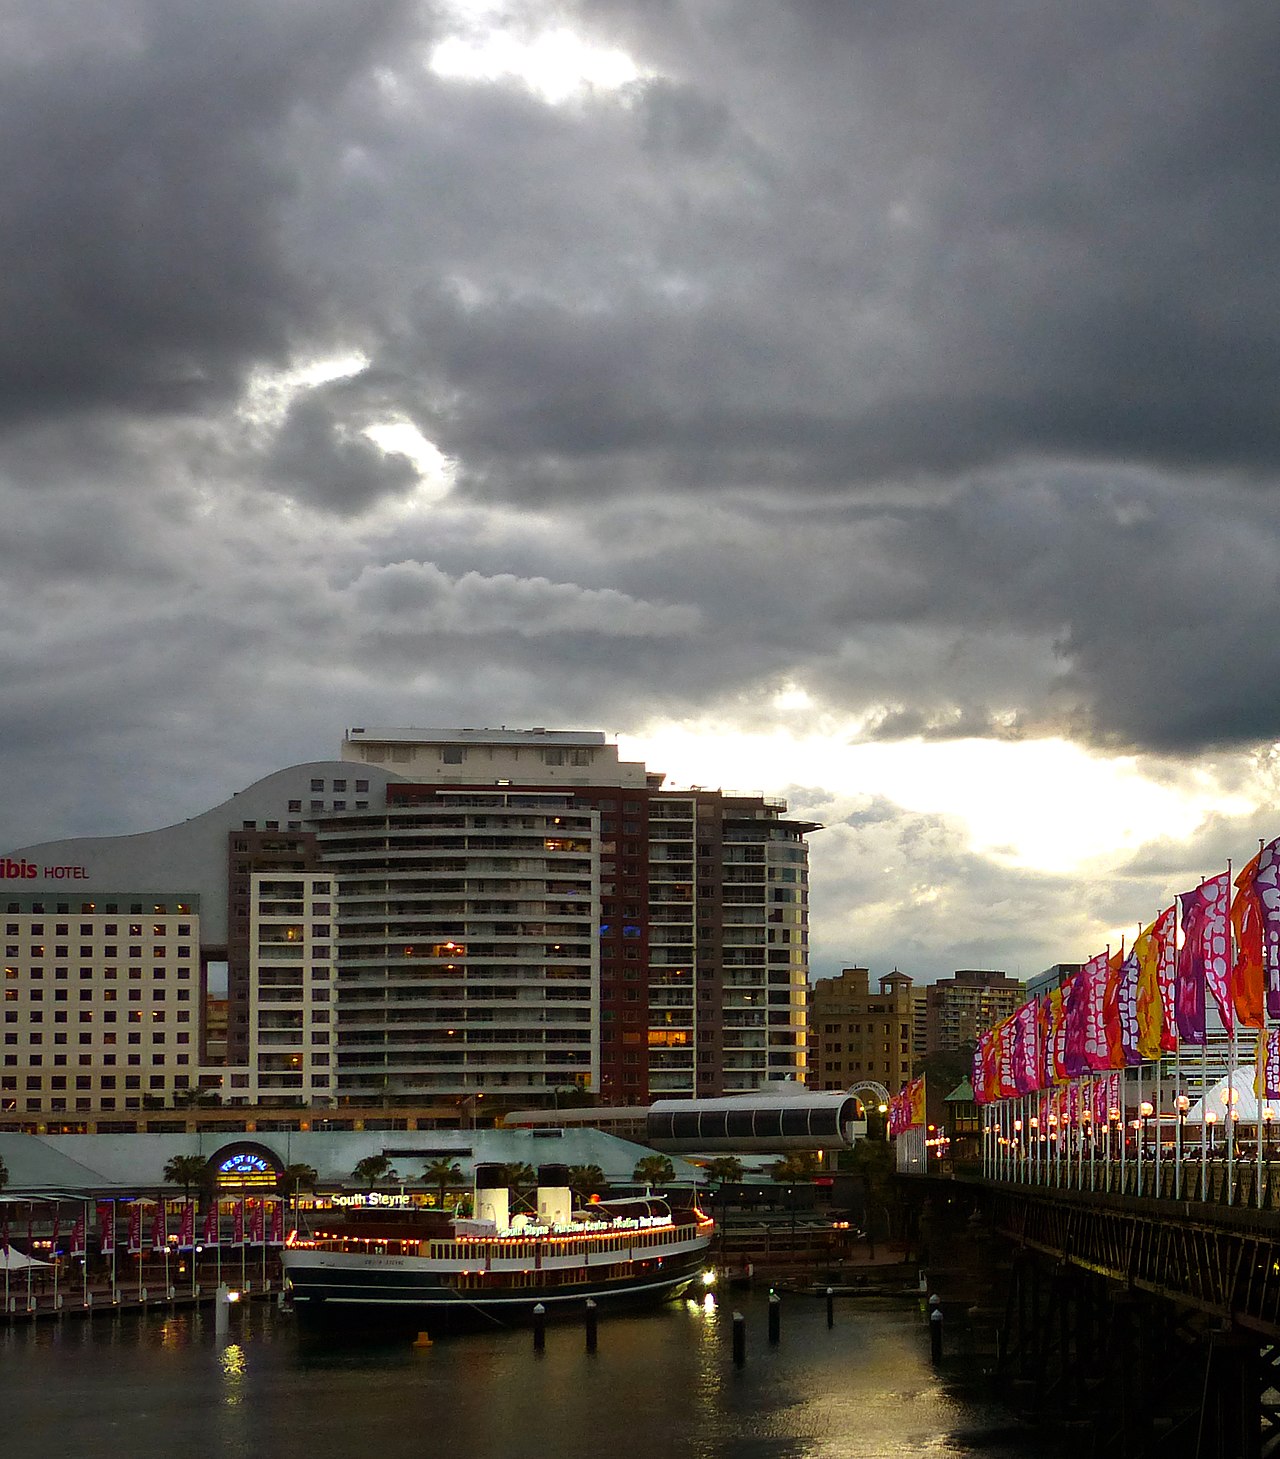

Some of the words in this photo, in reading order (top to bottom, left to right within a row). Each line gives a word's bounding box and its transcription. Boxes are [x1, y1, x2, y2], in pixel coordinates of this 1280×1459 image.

[0, 859, 37, 879] ibis
[44, 867, 90, 879] HOTEL
[221, 1155, 267, 1171] FESTIVAL
[332, 1193, 366, 1205] South
[368, 1192, 410, 1207] Steyne
